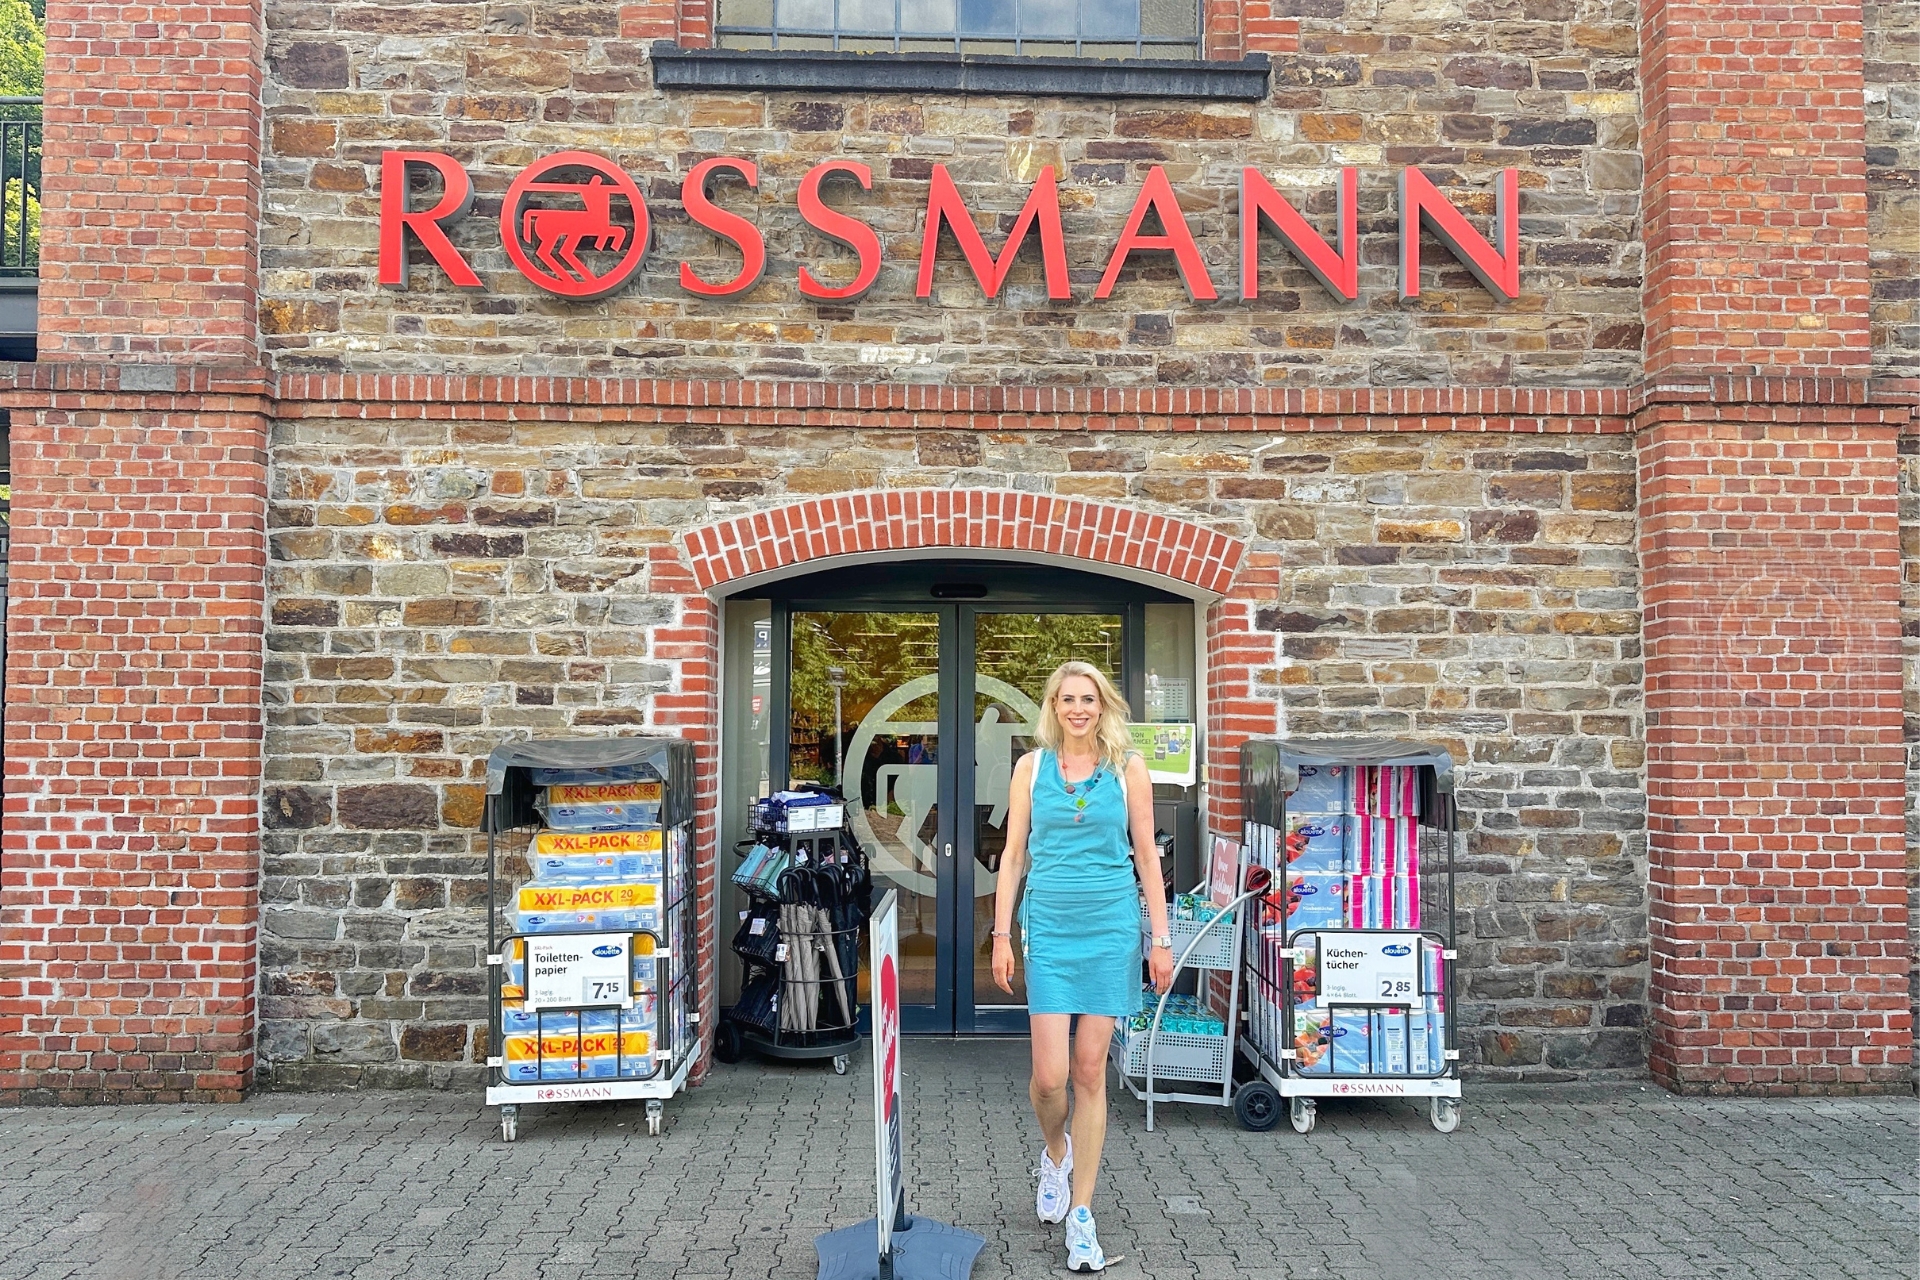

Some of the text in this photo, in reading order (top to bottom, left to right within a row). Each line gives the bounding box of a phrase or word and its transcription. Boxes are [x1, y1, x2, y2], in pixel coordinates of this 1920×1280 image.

[379, 150, 1520, 303] ROSSMANN
[564, 784, 656, 799] XXL-PACK 20
[553, 834, 650, 850] XXL-PACK 20
[534, 889, 634, 906] XXL-PACK 20
[535, 953, 584, 963] Toiletten-
[594, 947, 620, 956] alouette
[1326, 948, 1368, 958] Küchen-
[1383, 947, 1410, 956] alouette
[535, 965, 568, 978] papier
[1326, 960, 1360, 970] tücher
[592, 982, 620, 999] 7.15
[1381, 980, 1411, 998] 2.85
[524, 1037, 606, 1054] XXL-PACK
[537, 1087, 612, 1100] ROSSMANN
[1332, 1083, 1405, 1094] ROSSMANN
